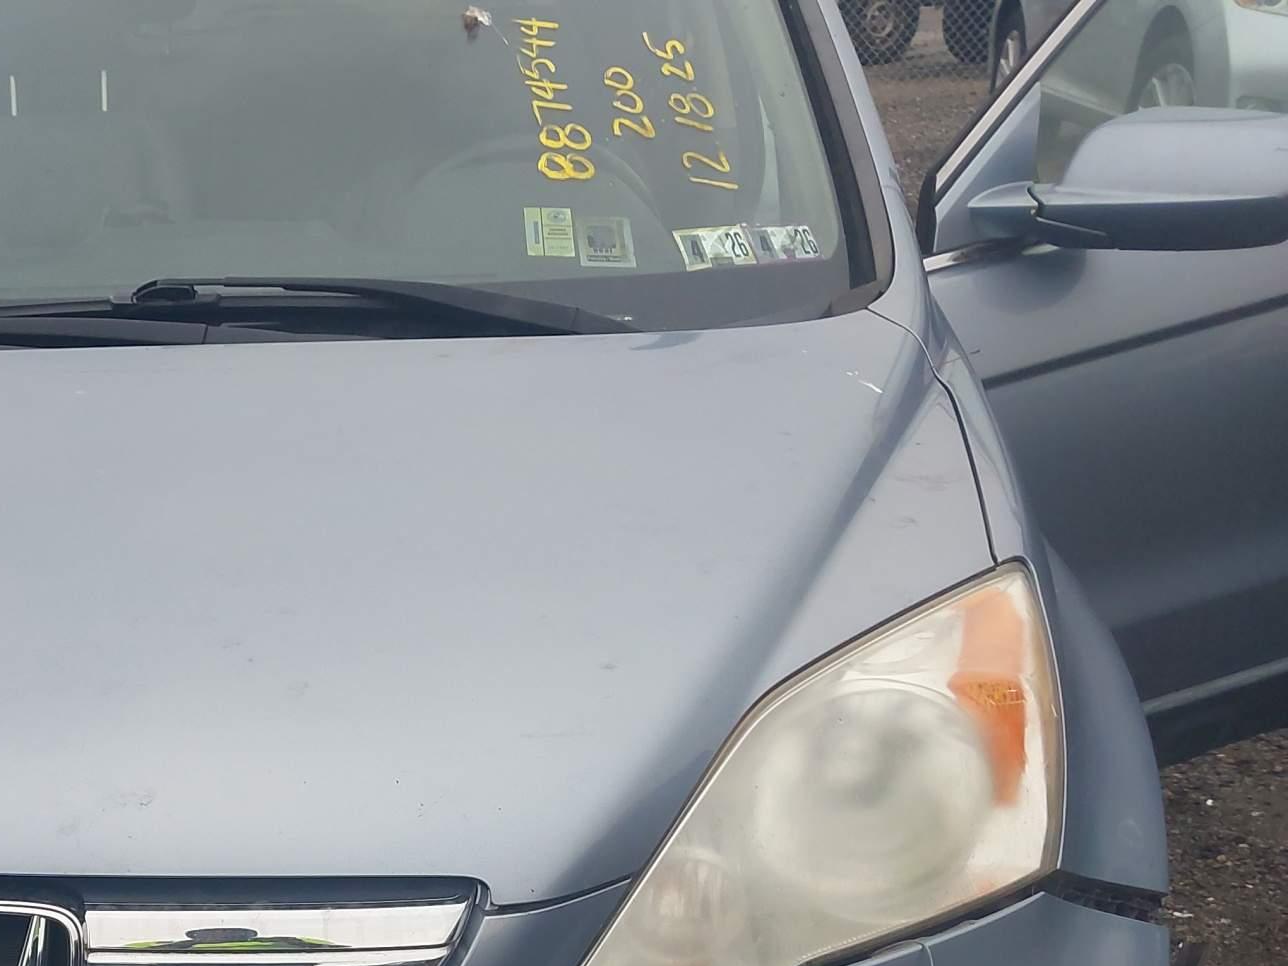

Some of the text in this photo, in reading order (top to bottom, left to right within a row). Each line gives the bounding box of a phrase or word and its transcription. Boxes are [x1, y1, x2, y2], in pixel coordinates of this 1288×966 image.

[512, 17, 596, 181] 8874544
[603, 66, 656, 139] 200
[642, 31, 739, 191] 12 18 25
[725, 231, 750, 258] 26
[793, 228, 819, 255] 26
